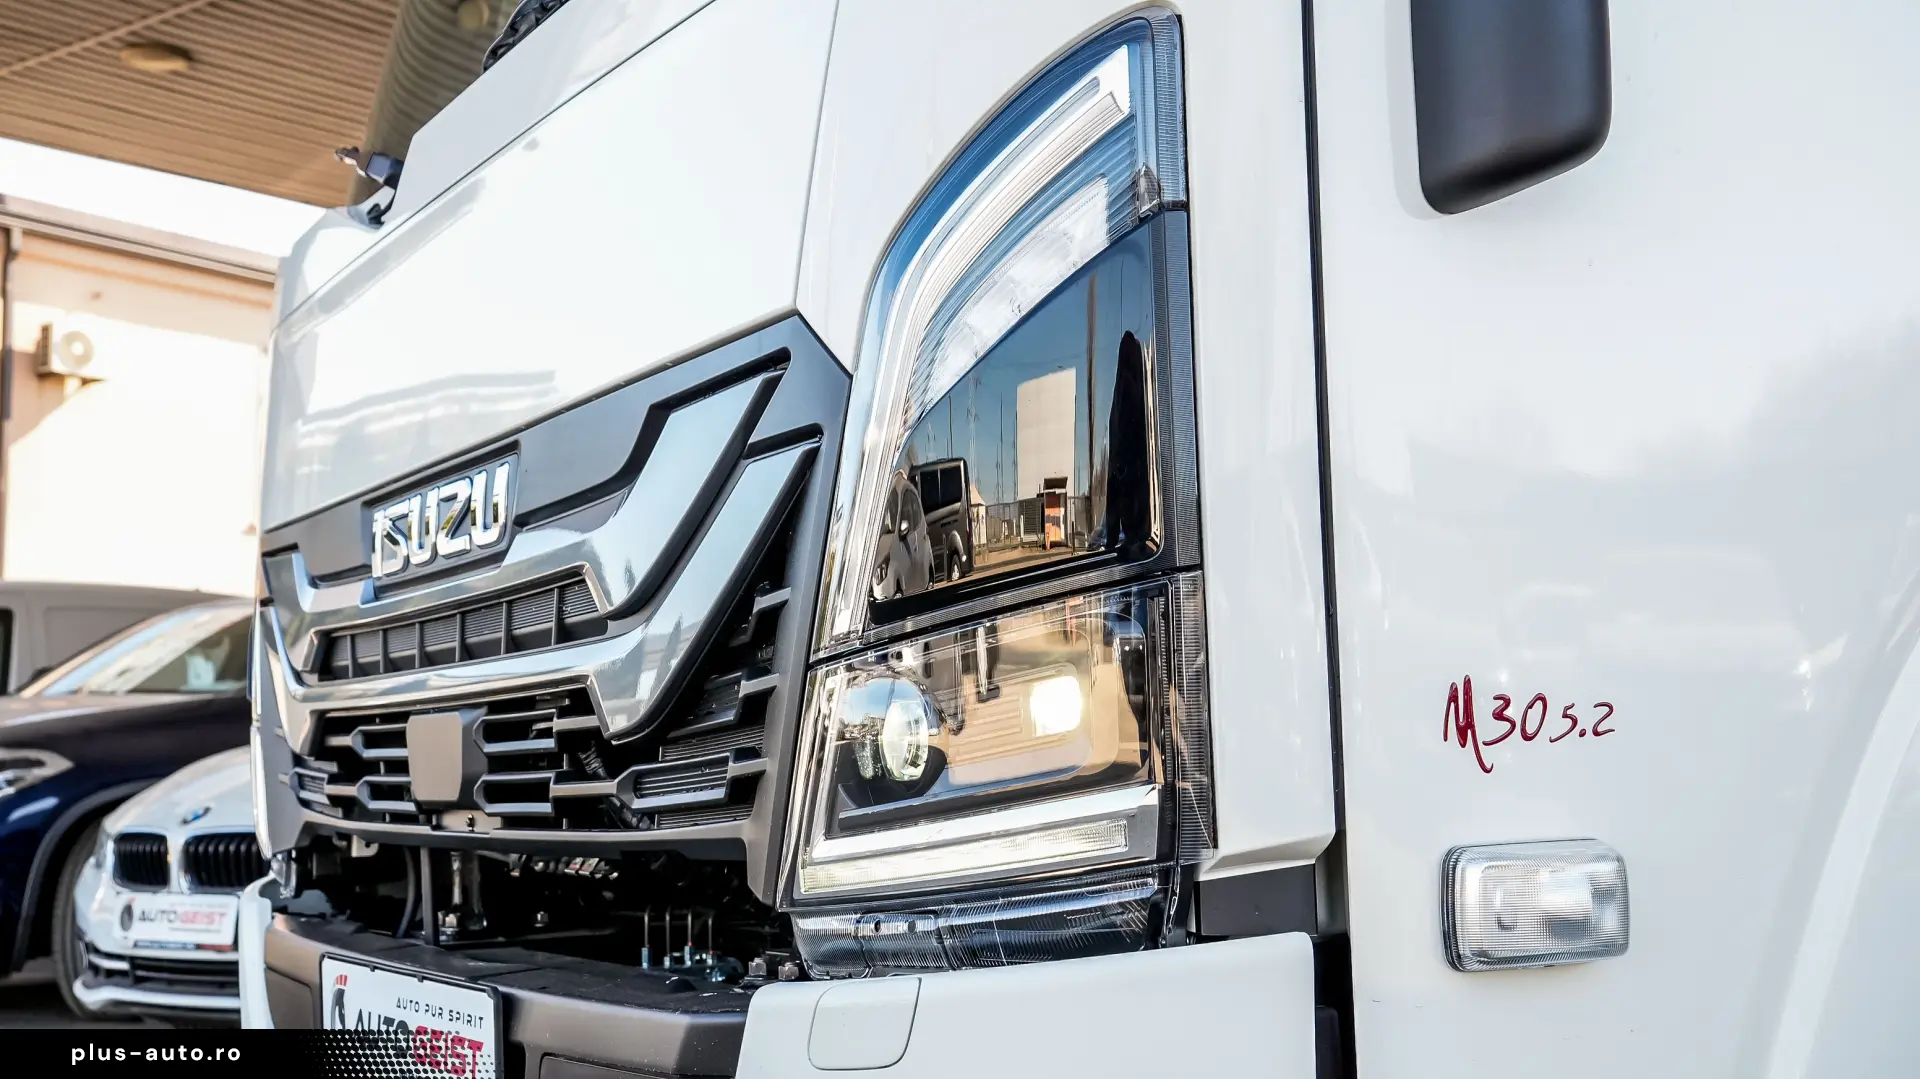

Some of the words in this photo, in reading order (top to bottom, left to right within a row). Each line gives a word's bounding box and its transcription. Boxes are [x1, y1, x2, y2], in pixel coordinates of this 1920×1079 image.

[372, 462, 511, 578] ISUZU
[396, 997, 420, 1013] AUTO
[424, 1003, 444, 1020] PUR
[448, 1009, 484, 1029] SPIRIT
